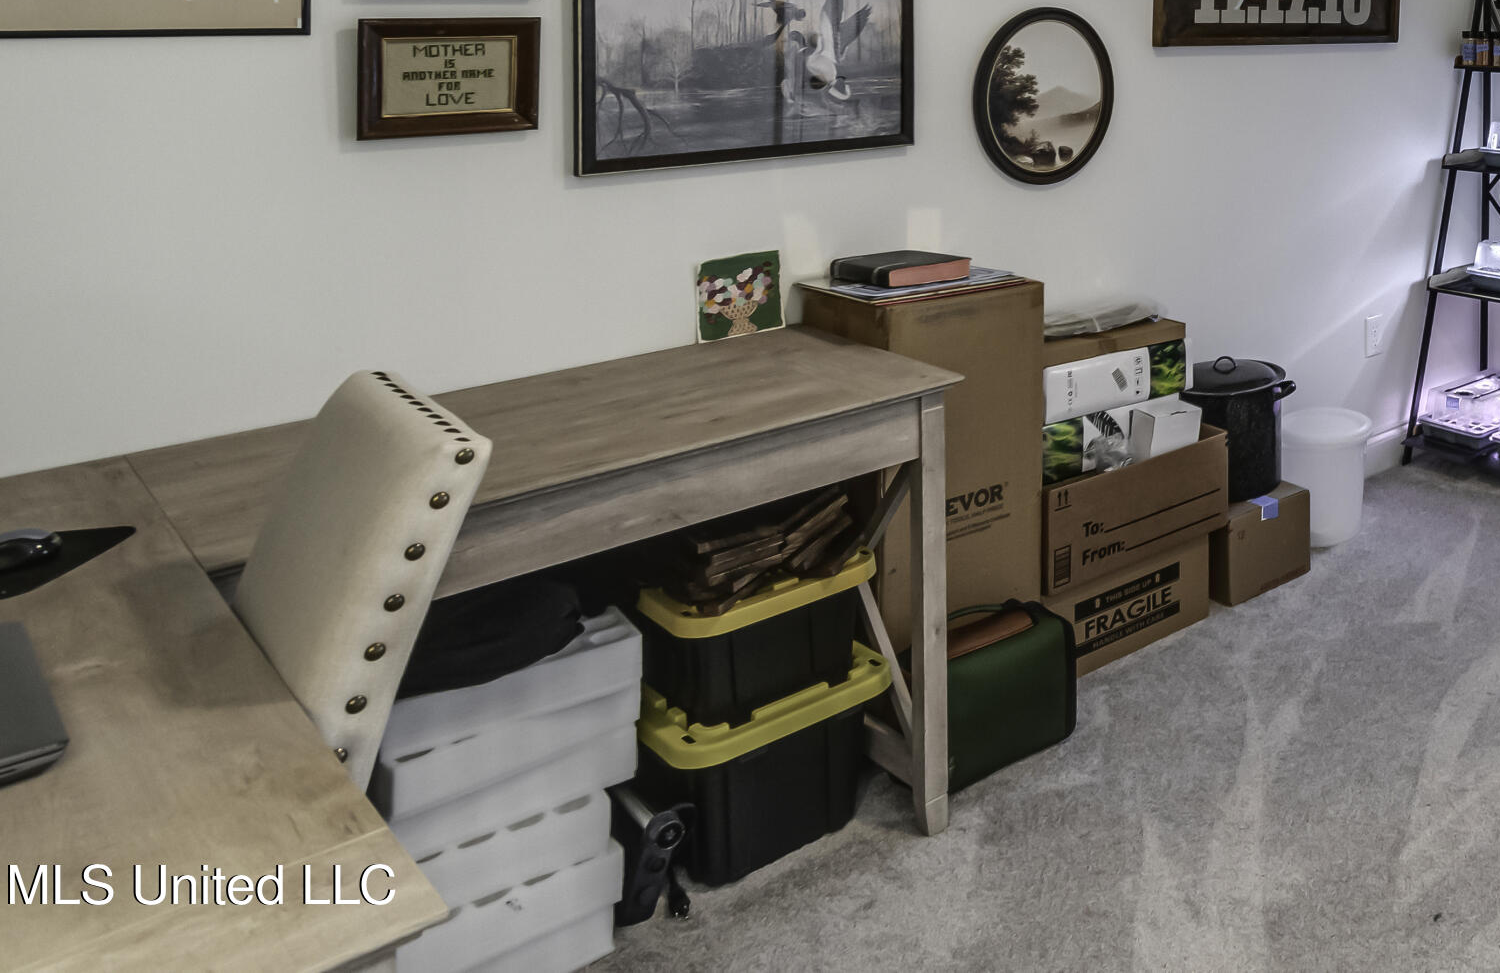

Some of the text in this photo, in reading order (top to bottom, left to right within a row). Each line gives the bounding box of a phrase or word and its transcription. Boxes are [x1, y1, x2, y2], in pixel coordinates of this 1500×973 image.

[412, 43, 486, 58] MOTHER
[444, 59, 456, 69] IS
[402, 68, 495, 81] ANOTHER NAME
[438, 81, 461, 91] FOR
[425, 92, 475, 106] LOVE
[945, 484, 1003, 517] EVOR
[1082, 521, 1104, 538] To:
[1082, 540, 1126, 566] From:
[1084, 586, 1173, 640] FRAGILE
